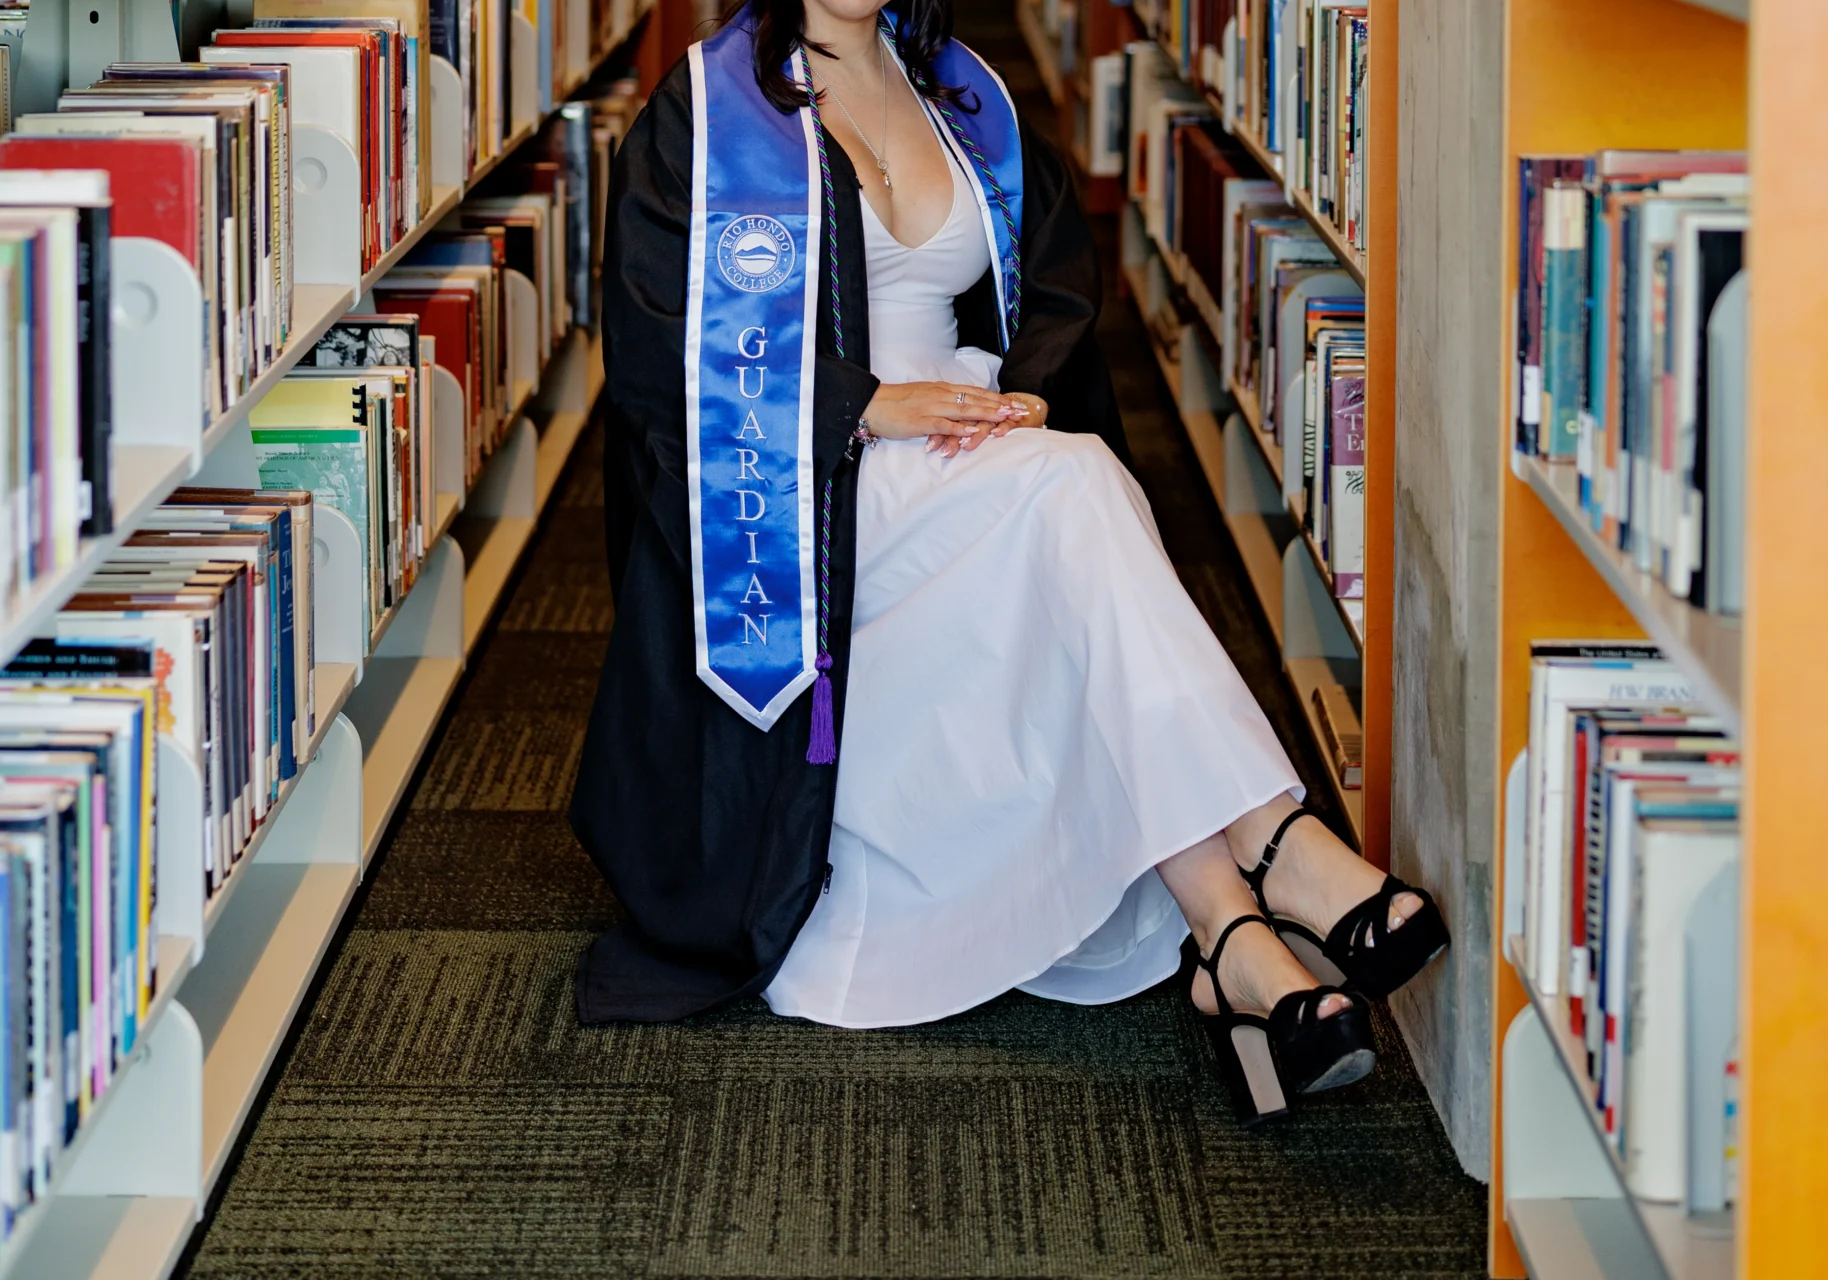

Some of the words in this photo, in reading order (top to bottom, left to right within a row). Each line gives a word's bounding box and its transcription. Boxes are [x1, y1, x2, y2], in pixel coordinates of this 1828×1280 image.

[722, 224, 742, 249] RÍO
[746, 219, 790, 251] HONDO
[726, 266, 784, 289] COLLEGE
[735, 326, 773, 646] GUARDIAN
